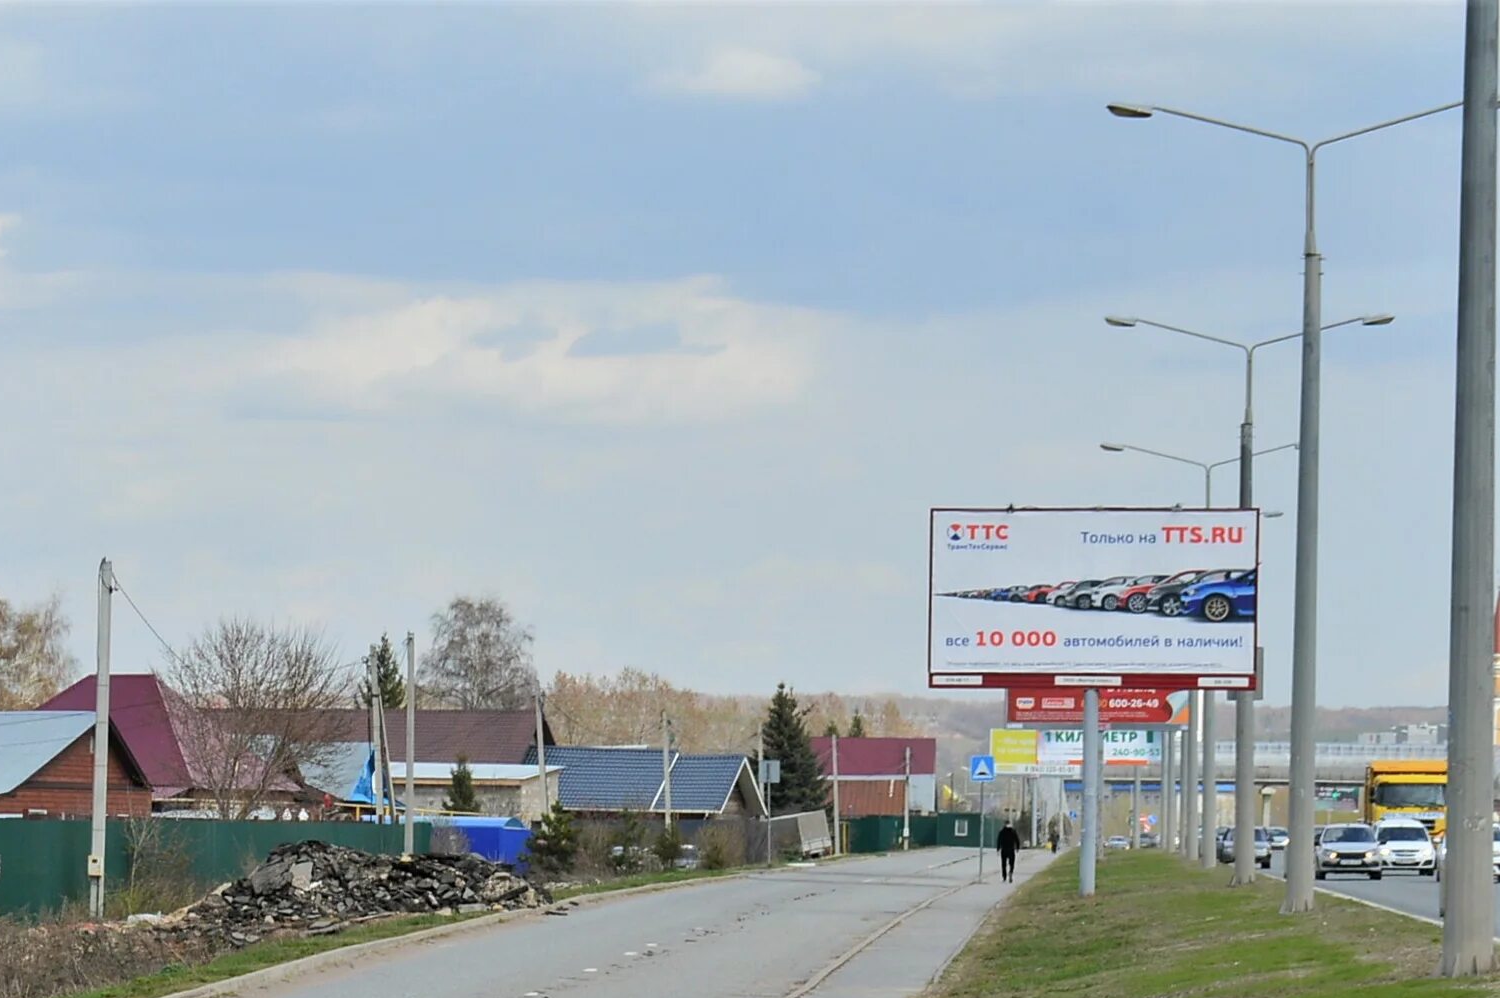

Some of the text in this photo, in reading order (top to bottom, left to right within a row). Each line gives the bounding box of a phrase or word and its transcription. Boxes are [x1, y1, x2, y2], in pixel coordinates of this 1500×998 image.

[966, 524, 1009, 540] ТТС
[1080, 526, 1243, 544] Только на TTS.RU
[945, 631, 1243, 648] все 10 000 автомобилей в наличии!
[1108, 698, 1159, 708] 600-26-49
